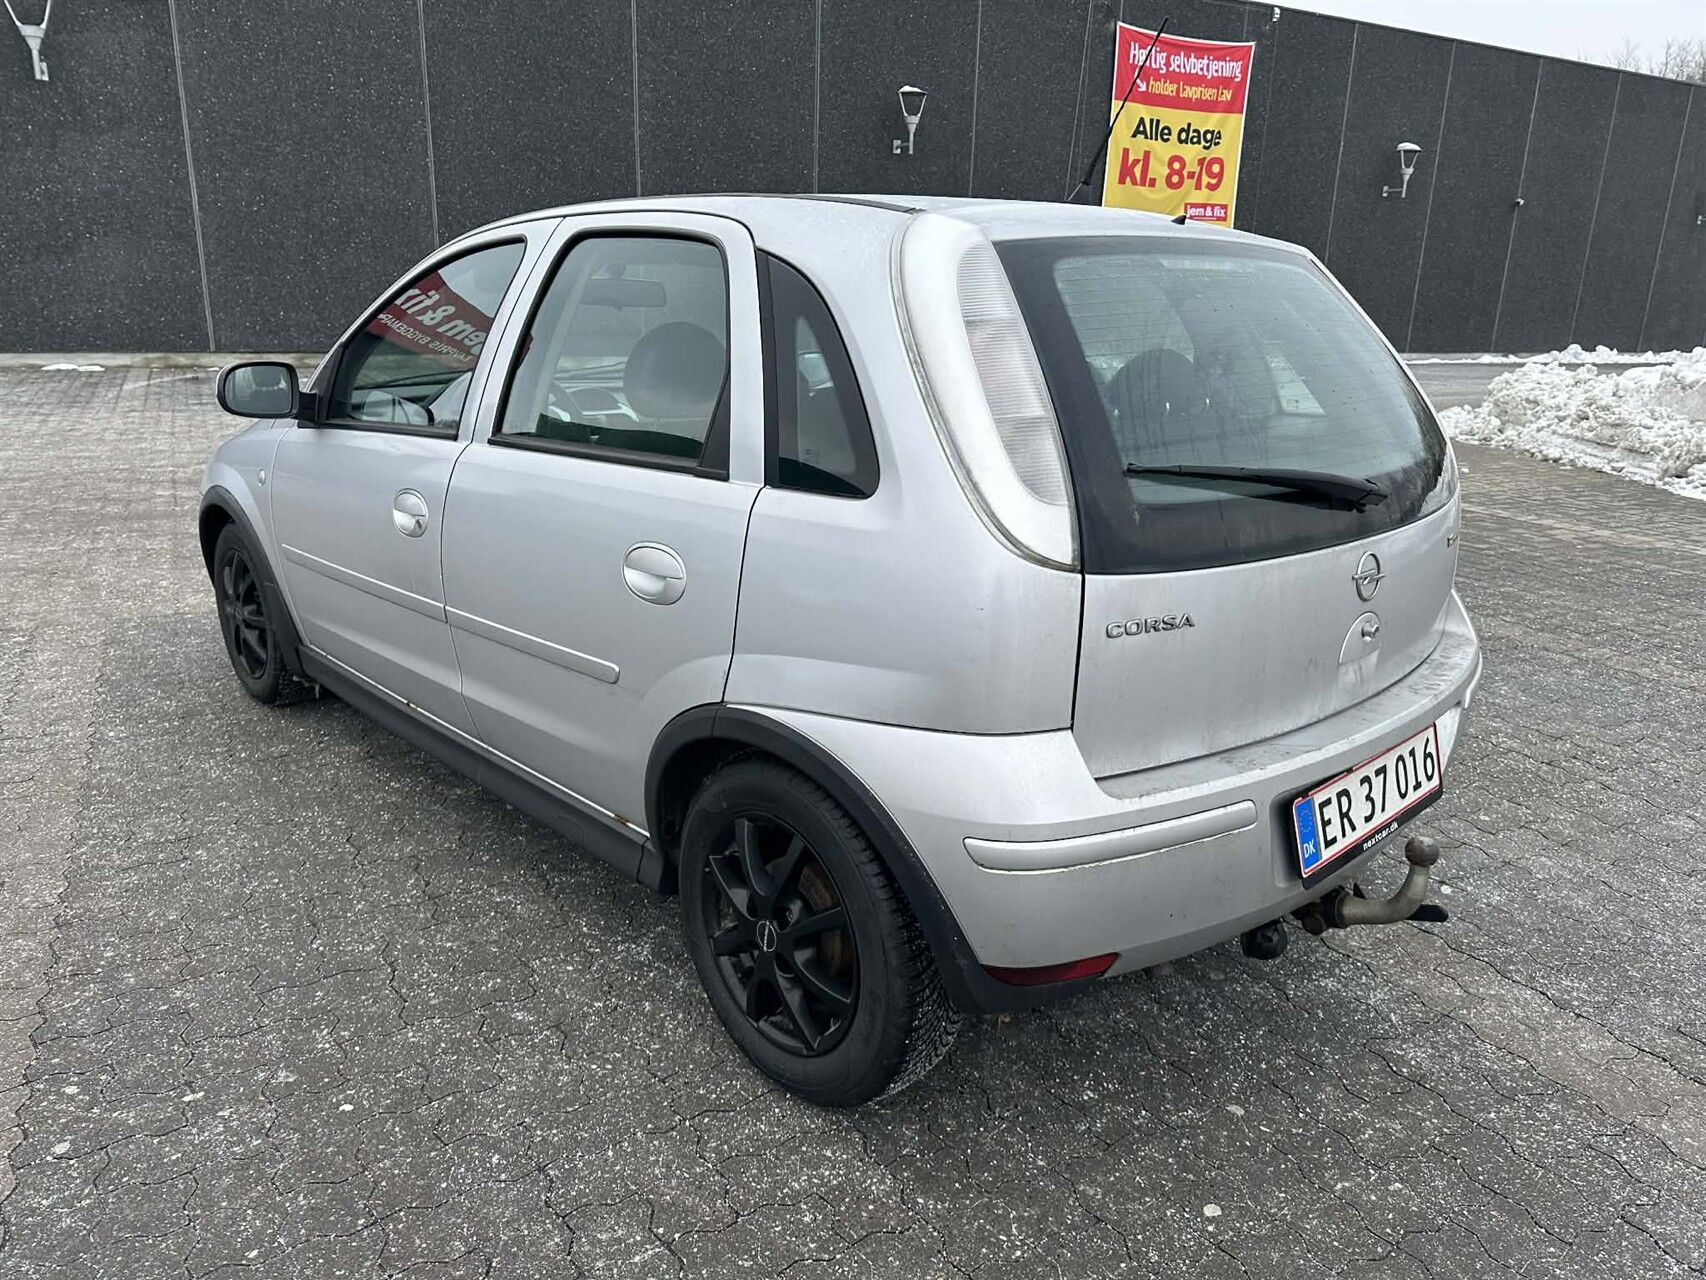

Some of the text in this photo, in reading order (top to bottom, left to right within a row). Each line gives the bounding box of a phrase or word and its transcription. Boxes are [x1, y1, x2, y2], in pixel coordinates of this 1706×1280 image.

[1169, 51, 1243, 82] selvbetjening
[1149, 76, 1177, 95] holder
[1131, 116, 1222, 150] Alle dage
[1117, 147, 1225, 192] kl. 8-19
[1186, 204, 1226, 218] jem & fix
[1105, 611, 1196, 639] CORSA
[1318, 736, 1435, 850] ER 37 016
[1303, 839, 1316, 858] DK
[1363, 821, 1399, 851] nextcar.dk
